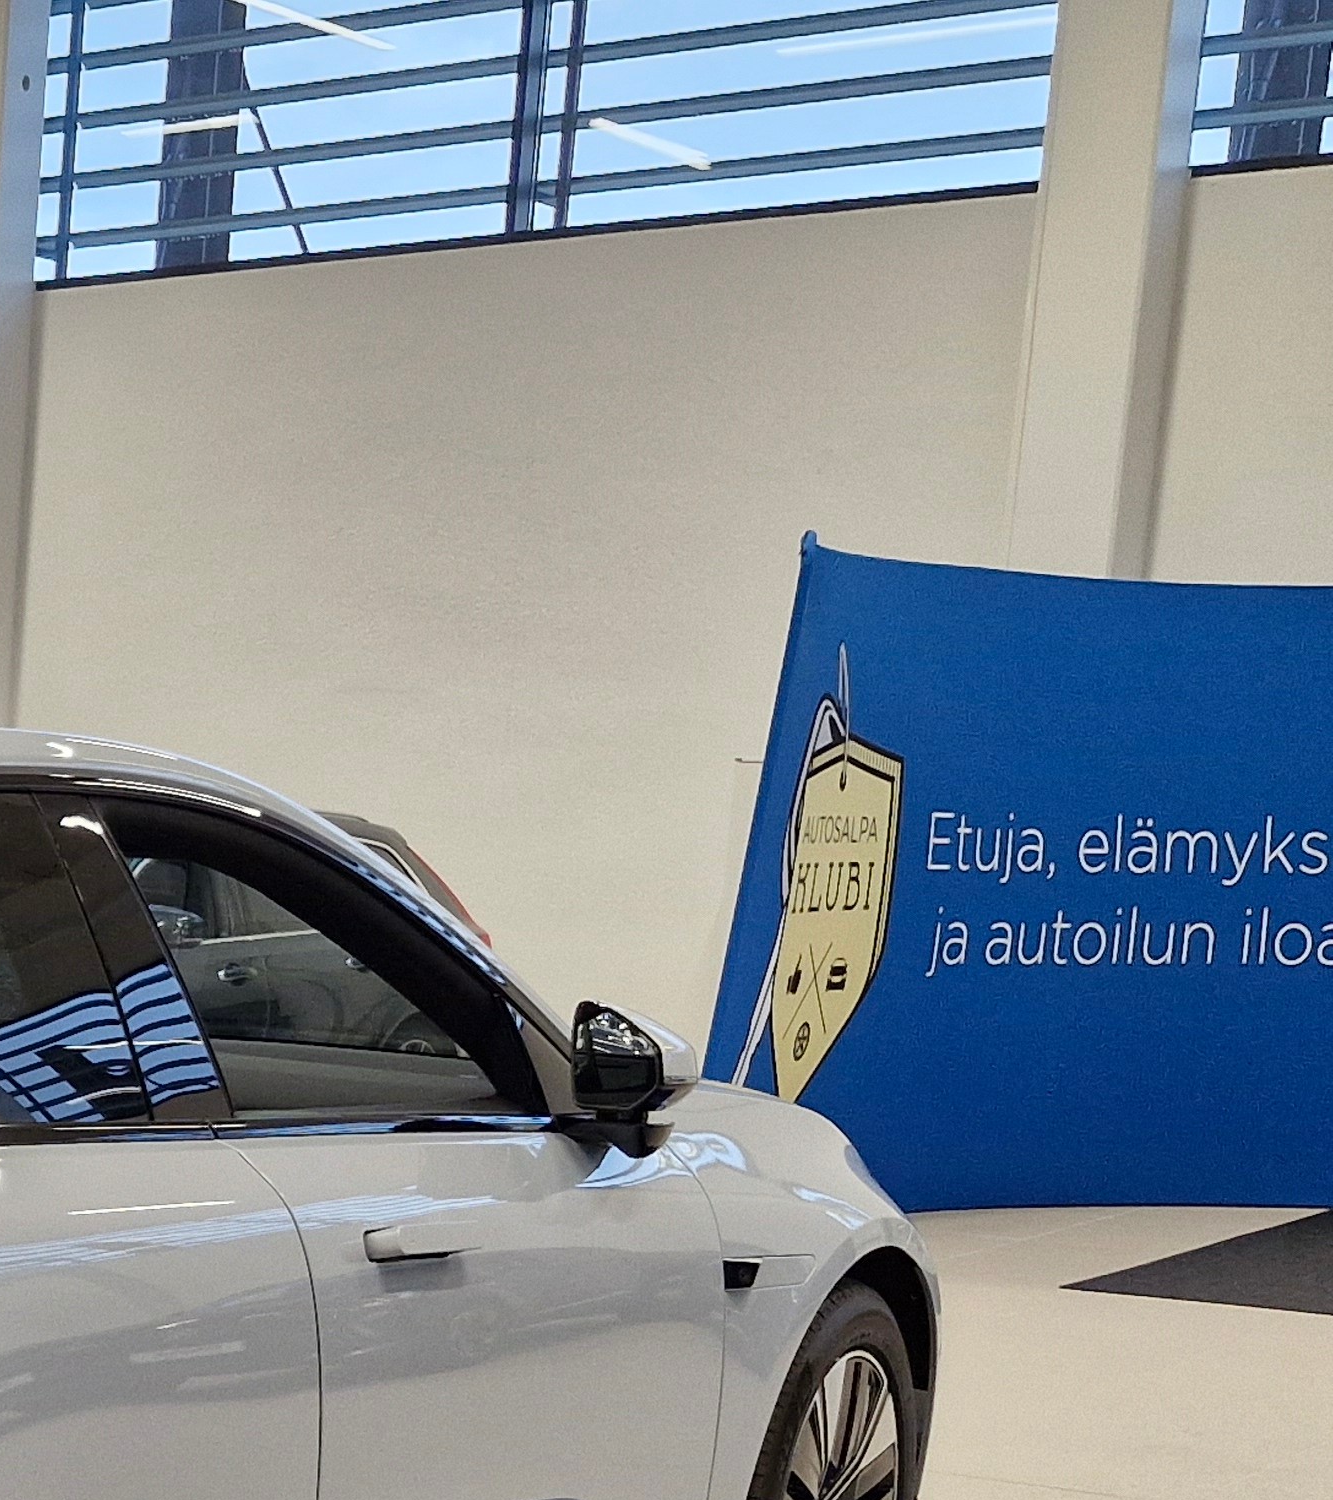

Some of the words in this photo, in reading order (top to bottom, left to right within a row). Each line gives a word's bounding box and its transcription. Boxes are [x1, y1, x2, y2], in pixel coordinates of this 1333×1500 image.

[801, 815, 879, 844] AUTOSALPA
[925, 810, 1056, 884] Etuja,
[1077, 812, 1330, 887] elämyks
[791, 861, 875, 914] KLUBI
[924, 905, 970, 978] ja
[984, 905, 1217, 967] autoilun
